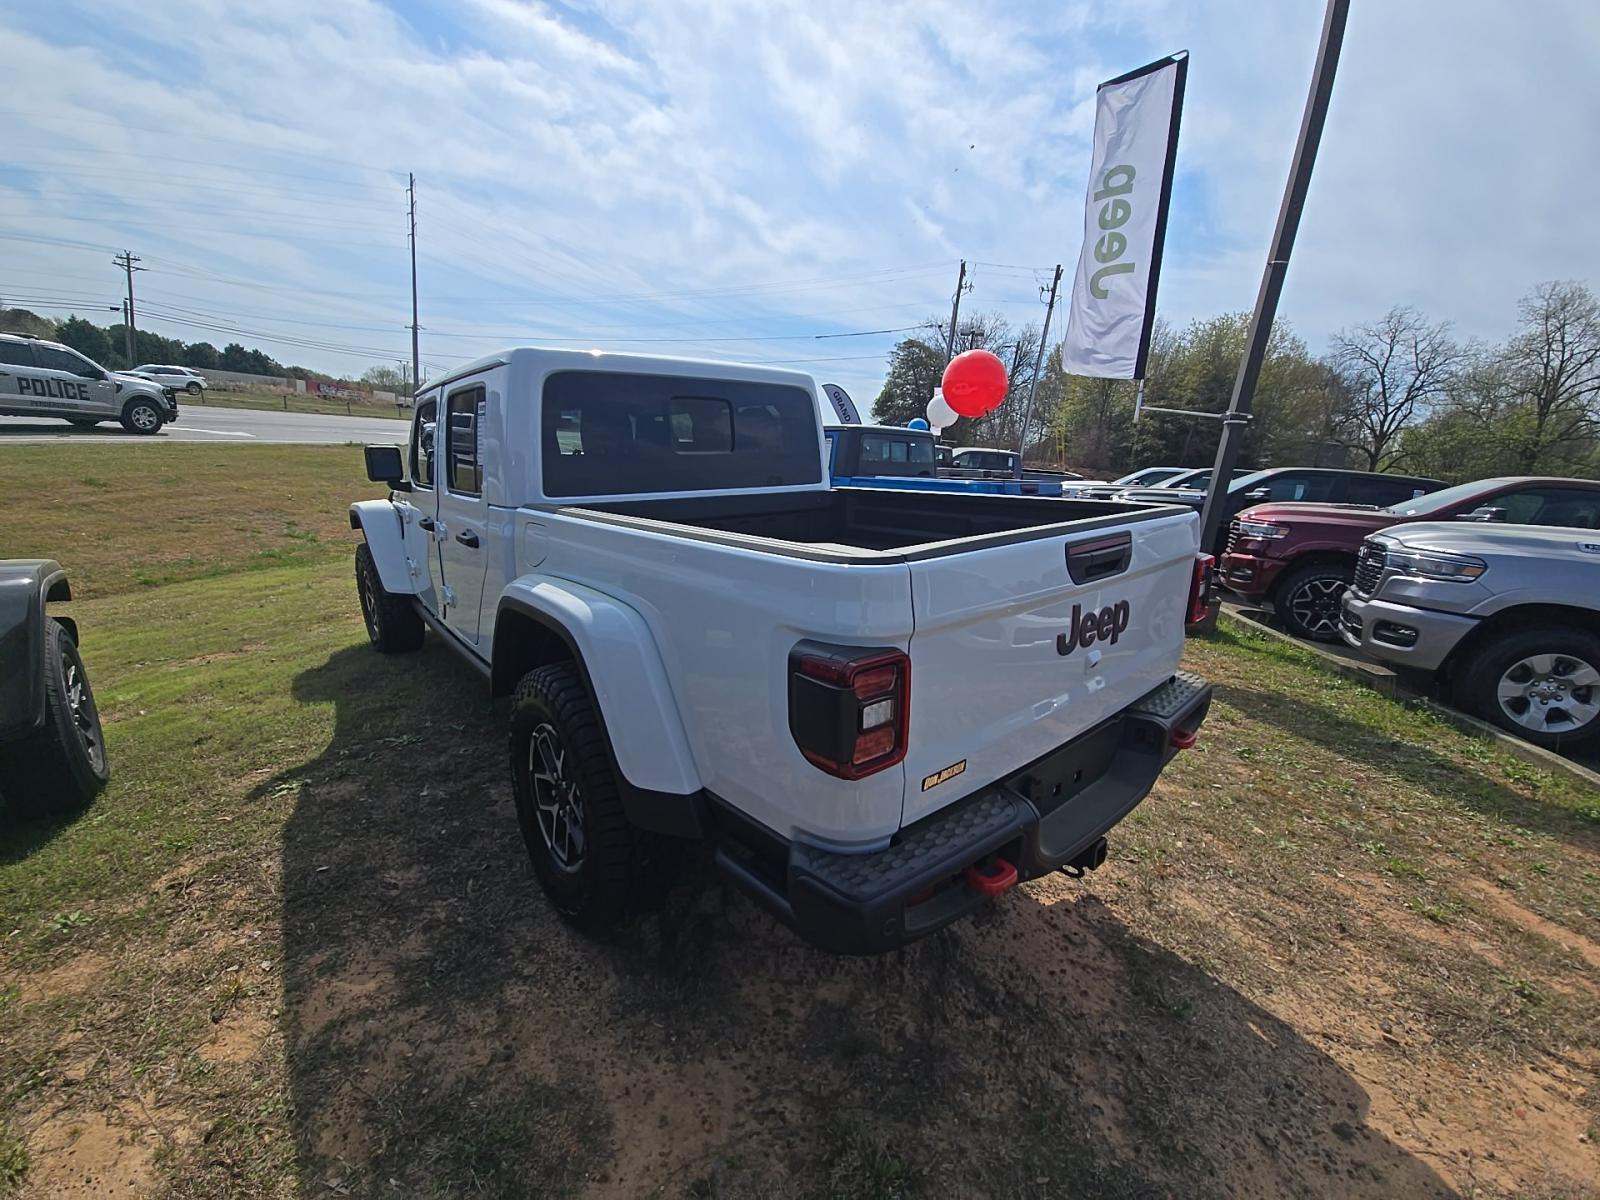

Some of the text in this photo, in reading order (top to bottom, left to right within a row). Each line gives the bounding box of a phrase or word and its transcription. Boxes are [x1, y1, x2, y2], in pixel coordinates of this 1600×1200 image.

[16, 376, 91, 401] POLICE
[833, 391, 851, 422] GRAND
[1056, 599, 1130, 656] Jeep
